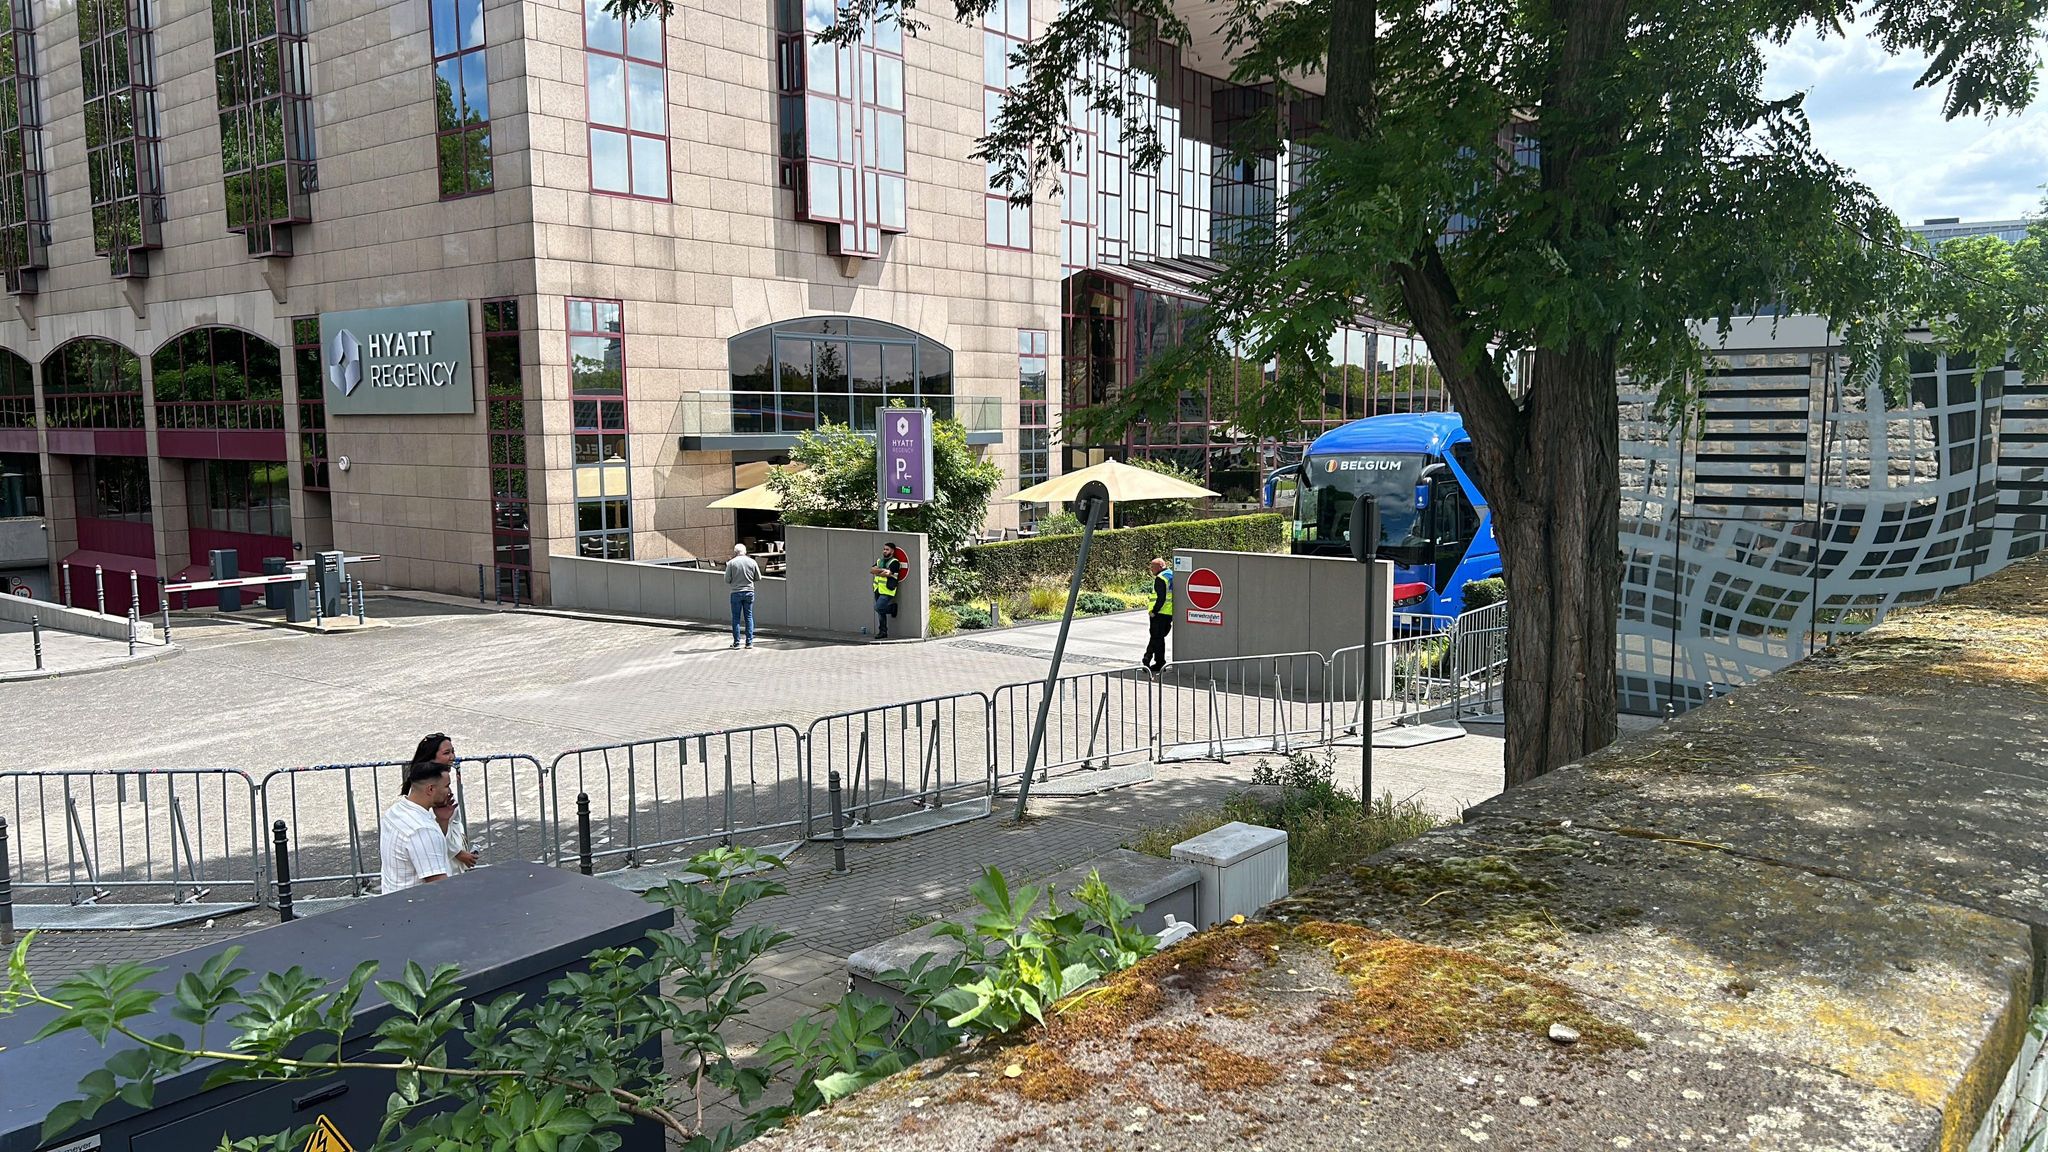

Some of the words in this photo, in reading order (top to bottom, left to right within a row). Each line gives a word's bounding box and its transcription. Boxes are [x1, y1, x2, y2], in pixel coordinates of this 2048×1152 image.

[368, 330, 432, 357] HYATT
[370, 361, 456, 387] REGENCY
[896, 458, 906, 479] P
[1340, 460, 1402, 471] BELGIUM
